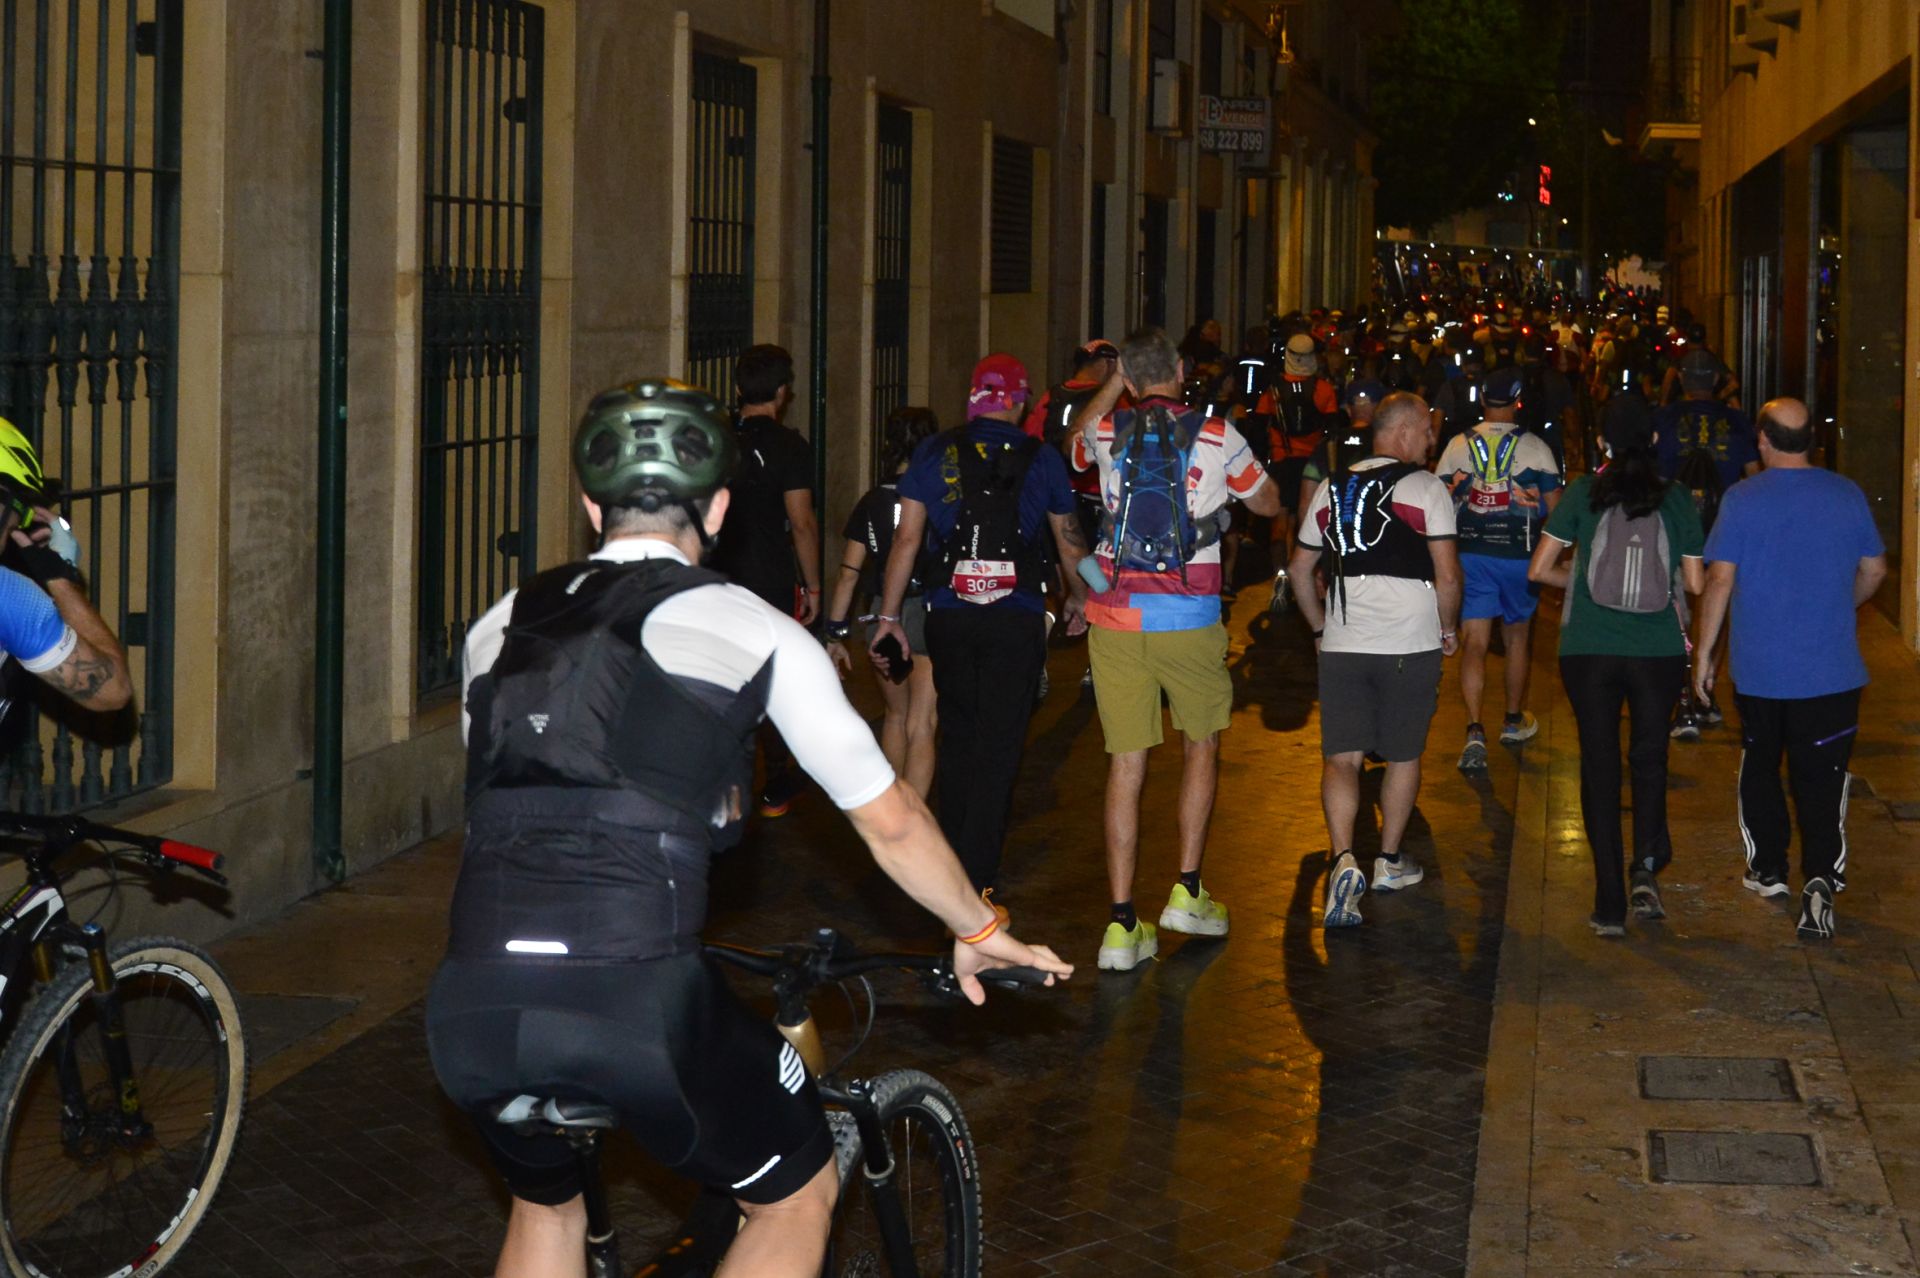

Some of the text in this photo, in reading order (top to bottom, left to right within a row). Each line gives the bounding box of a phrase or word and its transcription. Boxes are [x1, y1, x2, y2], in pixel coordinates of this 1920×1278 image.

[1217, 131, 1239, 150] 222
[1241, 132, 1263, 151] 899
[1476, 493, 1497, 505] 231
[966, 579, 998, 593] 306
